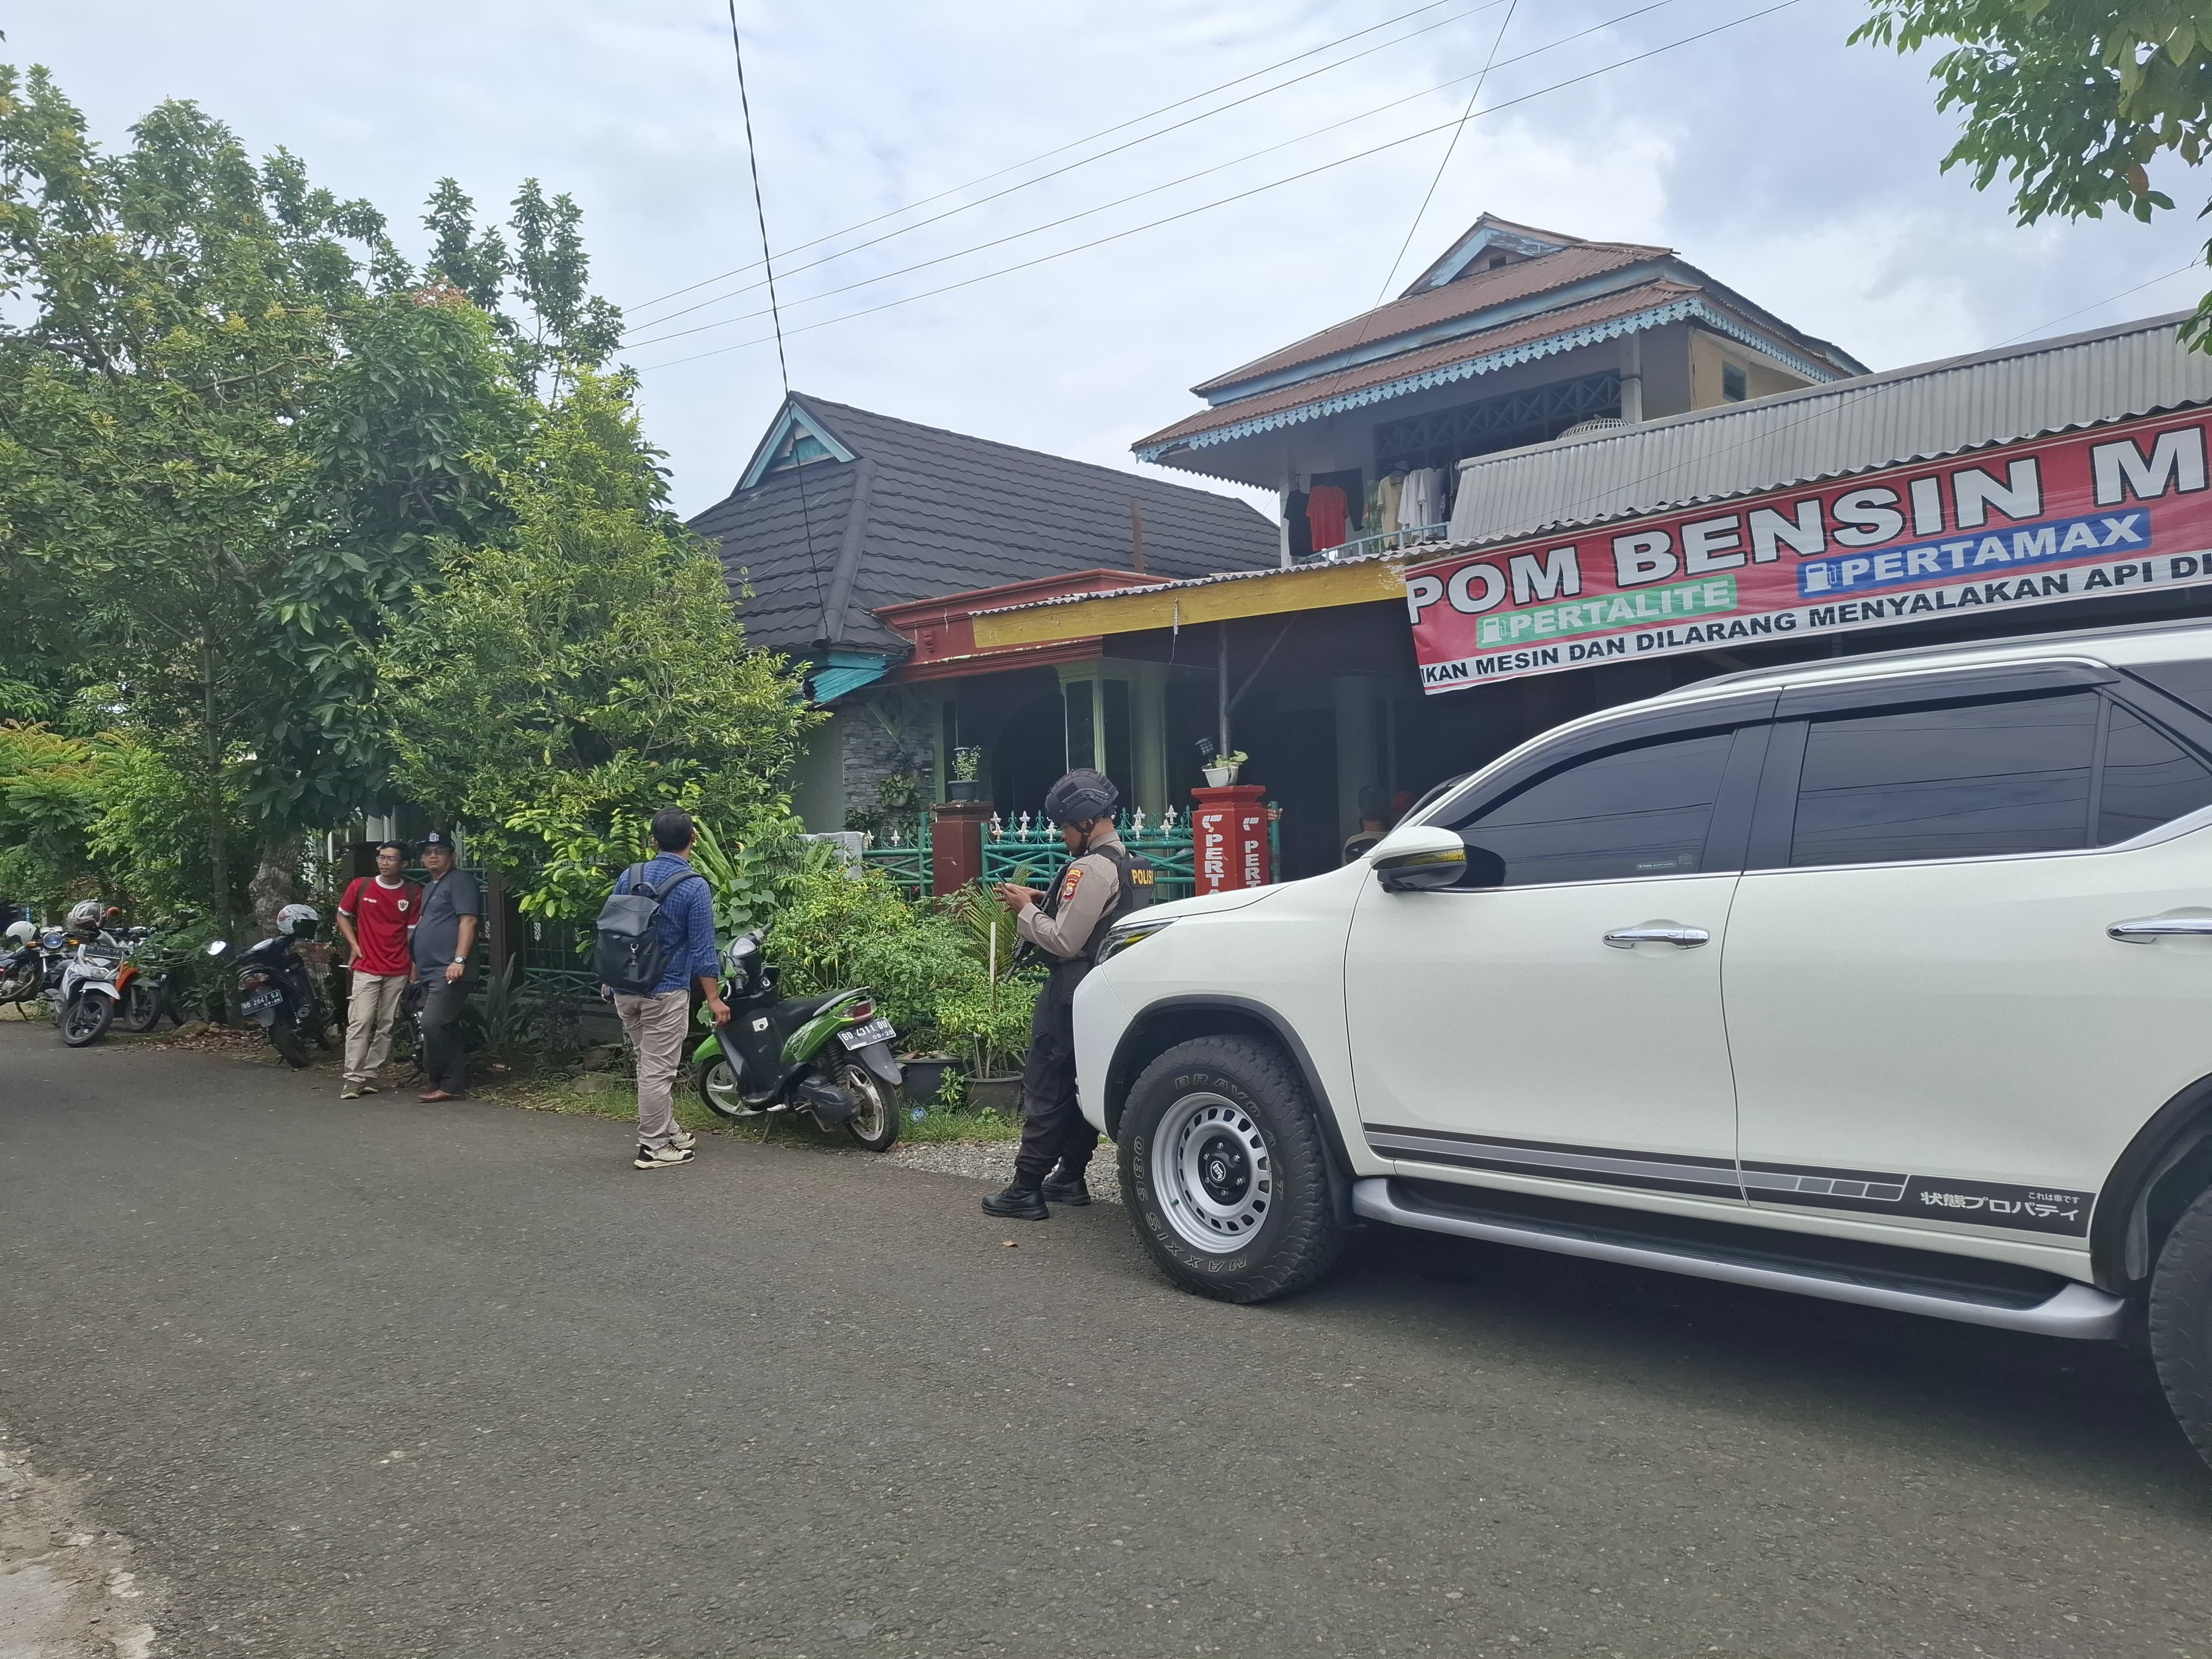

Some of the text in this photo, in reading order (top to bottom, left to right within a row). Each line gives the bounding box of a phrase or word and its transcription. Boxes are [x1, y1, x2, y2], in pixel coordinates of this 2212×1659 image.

[1406, 424, 2210, 625] POM BENSIN M
[1842, 513, 2143, 586] PERTAMAX
[1476, 647, 1559, 676] MESIN
[1569, 637, 1625, 659] DAN
[1636, 612, 1797, 651] DILARANG
[1809, 573, 2069, 627] MENYALAKAN
[2084, 561, 2153, 590] API
[1510, 580, 1730, 638] PERTALITE
[1131, 869, 1153, 885] POLISI
[841, 1031, 854, 1041] BD
[877, 1020, 888, 1030] DU
[1175, 1073, 1261, 1118] BRAVO
[1133, 1136, 1247, 1273] MAXXIS 980
[1920, 1191, 2079, 1221] 状態プロパティ
[2028, 1192, 2080, 1204] これは車です
